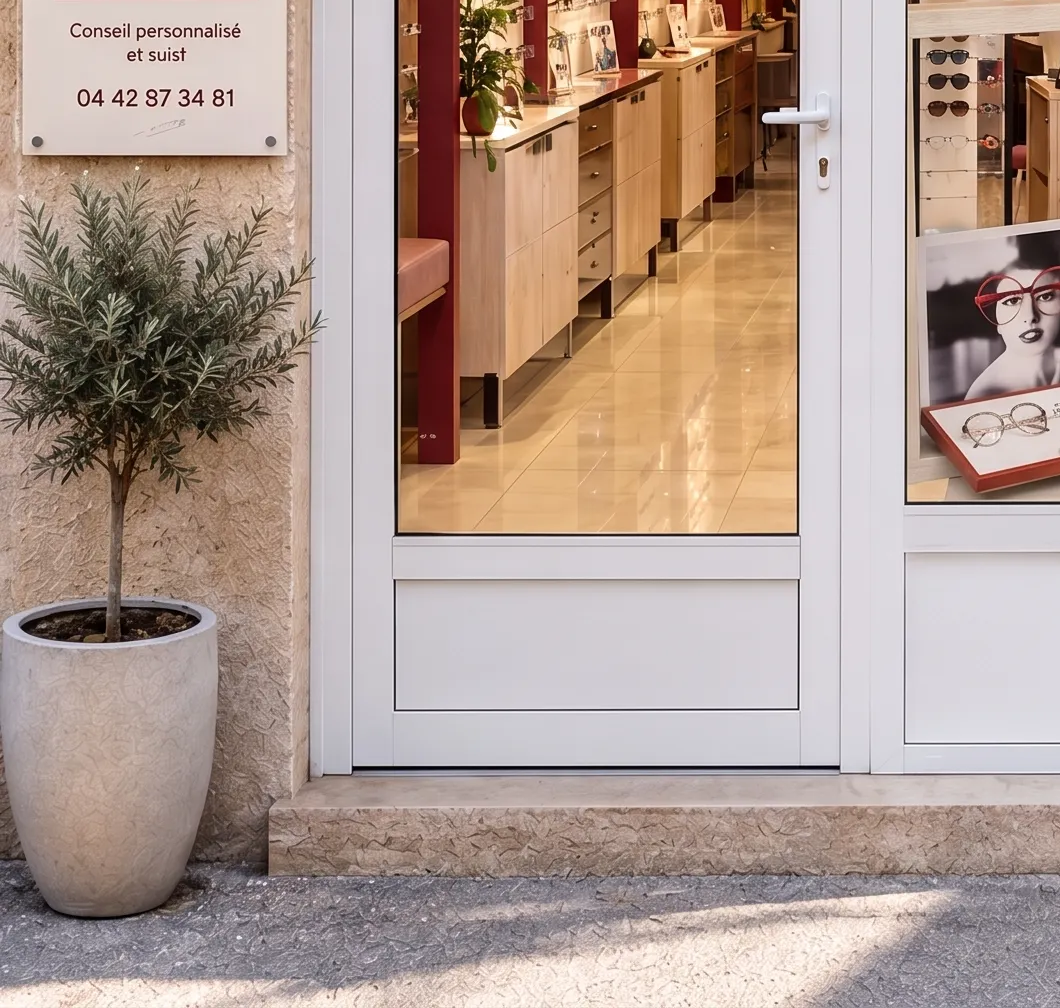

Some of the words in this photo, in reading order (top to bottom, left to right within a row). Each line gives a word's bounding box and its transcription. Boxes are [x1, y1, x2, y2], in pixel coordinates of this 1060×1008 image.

[69, 22, 131, 39] Conseil
[136, 22, 242, 42] personnalisé
[126, 47, 144, 62] et
[77, 88, 105, 108] 04
[111, 88, 139, 108] 42
[145, 88, 172, 108] 87
[177, 88, 205, 108] 34
[212, 88, 234, 108] 81
